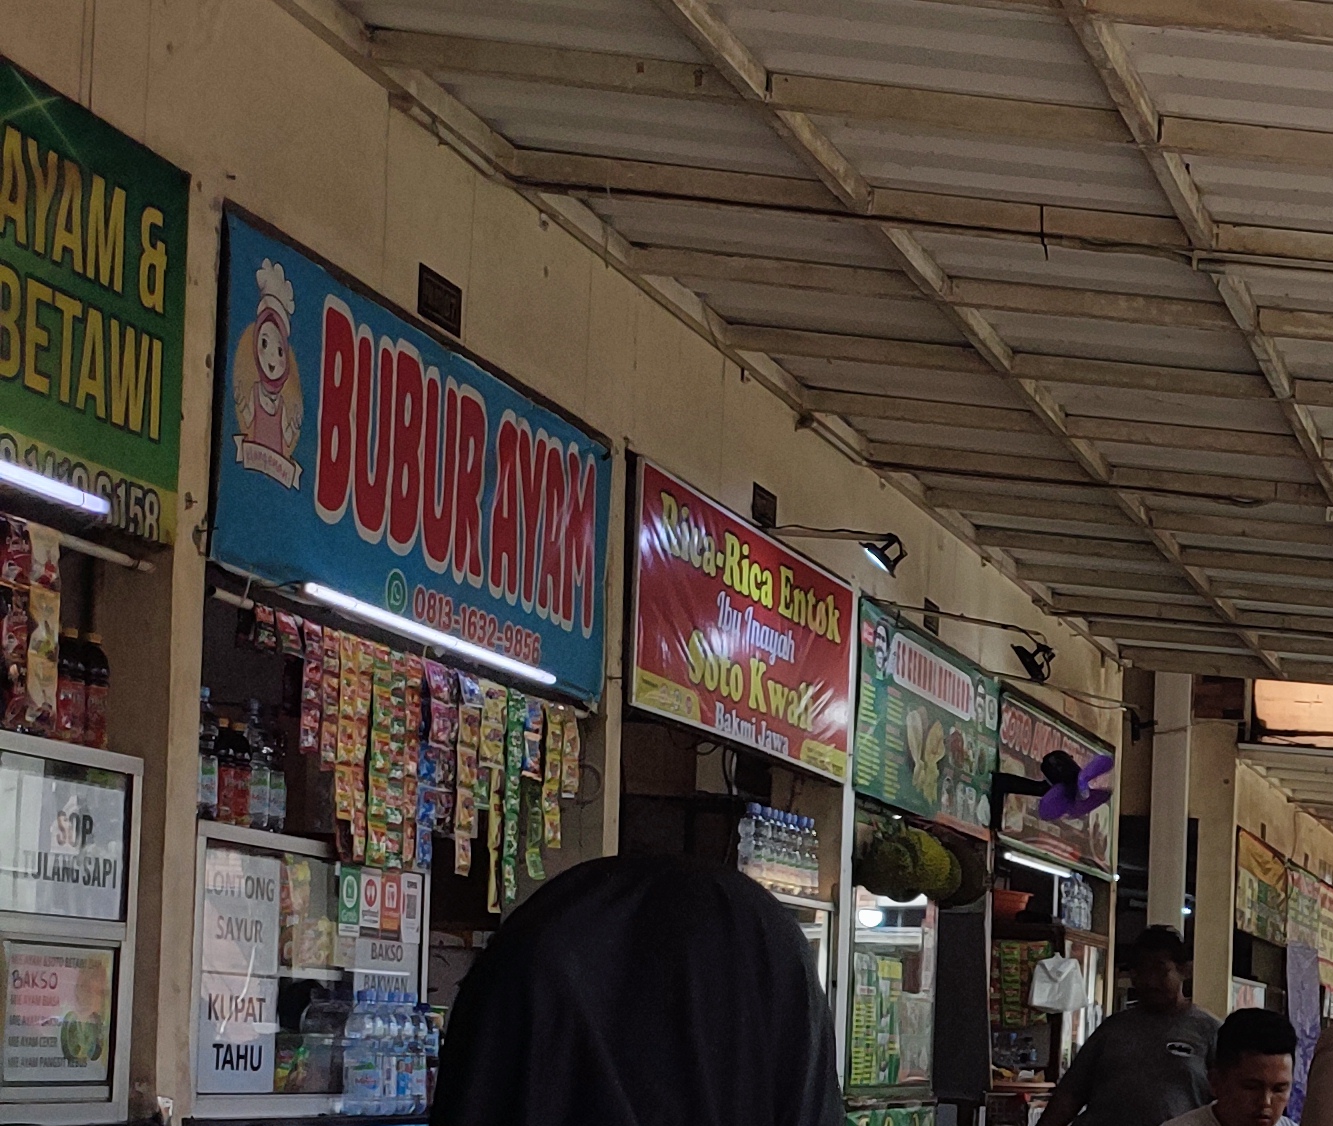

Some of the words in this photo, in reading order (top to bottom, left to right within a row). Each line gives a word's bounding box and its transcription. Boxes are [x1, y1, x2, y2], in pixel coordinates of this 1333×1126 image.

[0, 124, 127, 294] AYAM
[139, 205, 168, 315] &
[0, 262, 163, 441] BETAWI
[316, 295, 487, 587] BUBUR
[490, 410, 596, 638] AYAM
[779, 566, 841, 644] Entok
[413, 586, 541, 666] 0813-1632-9856
[715, 701, 756, 746] Bakmi
[758, 721, 789, 756] Jawa
[56, 810, 94, 848] SOP
[82, 856, 118, 889] SAPI
[206, 870, 276, 902] LONTONG
[216, 915, 264, 944] SAYUR
[371, 942, 404, 962] BAKSO
[12, 969, 59, 990] BAKSO
[208, 993, 266, 1024] KUPAT
[212, 1043, 263, 1072] TAHU
